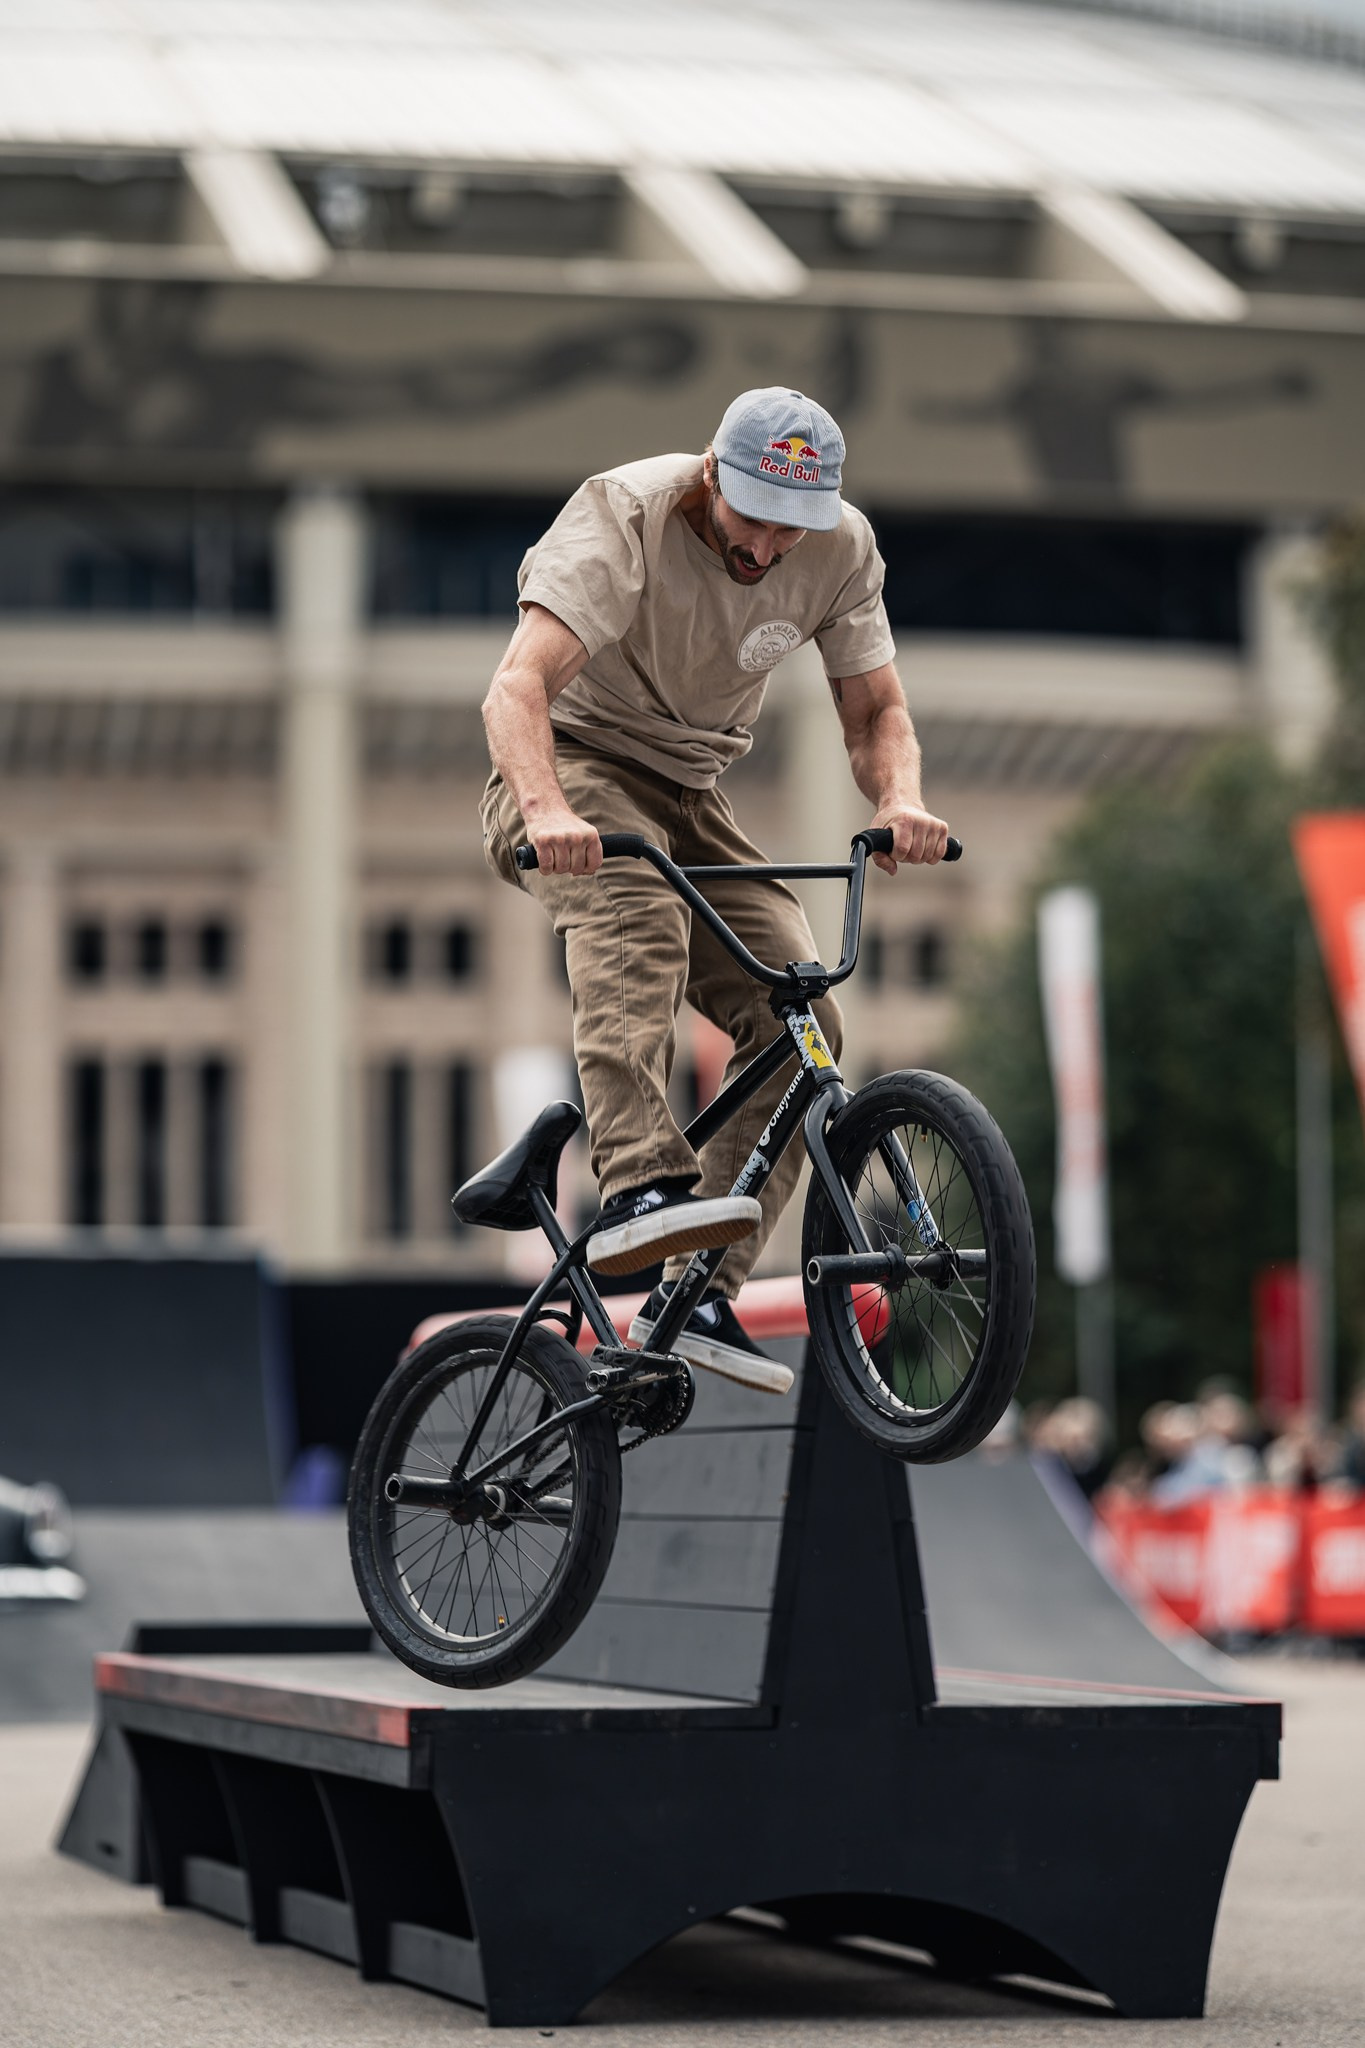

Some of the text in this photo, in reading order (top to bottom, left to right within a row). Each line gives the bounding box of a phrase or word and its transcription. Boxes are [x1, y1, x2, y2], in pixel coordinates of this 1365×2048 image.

[759, 456, 821, 483] Red Bull
[760, 624, 798, 641] ALWAYS
